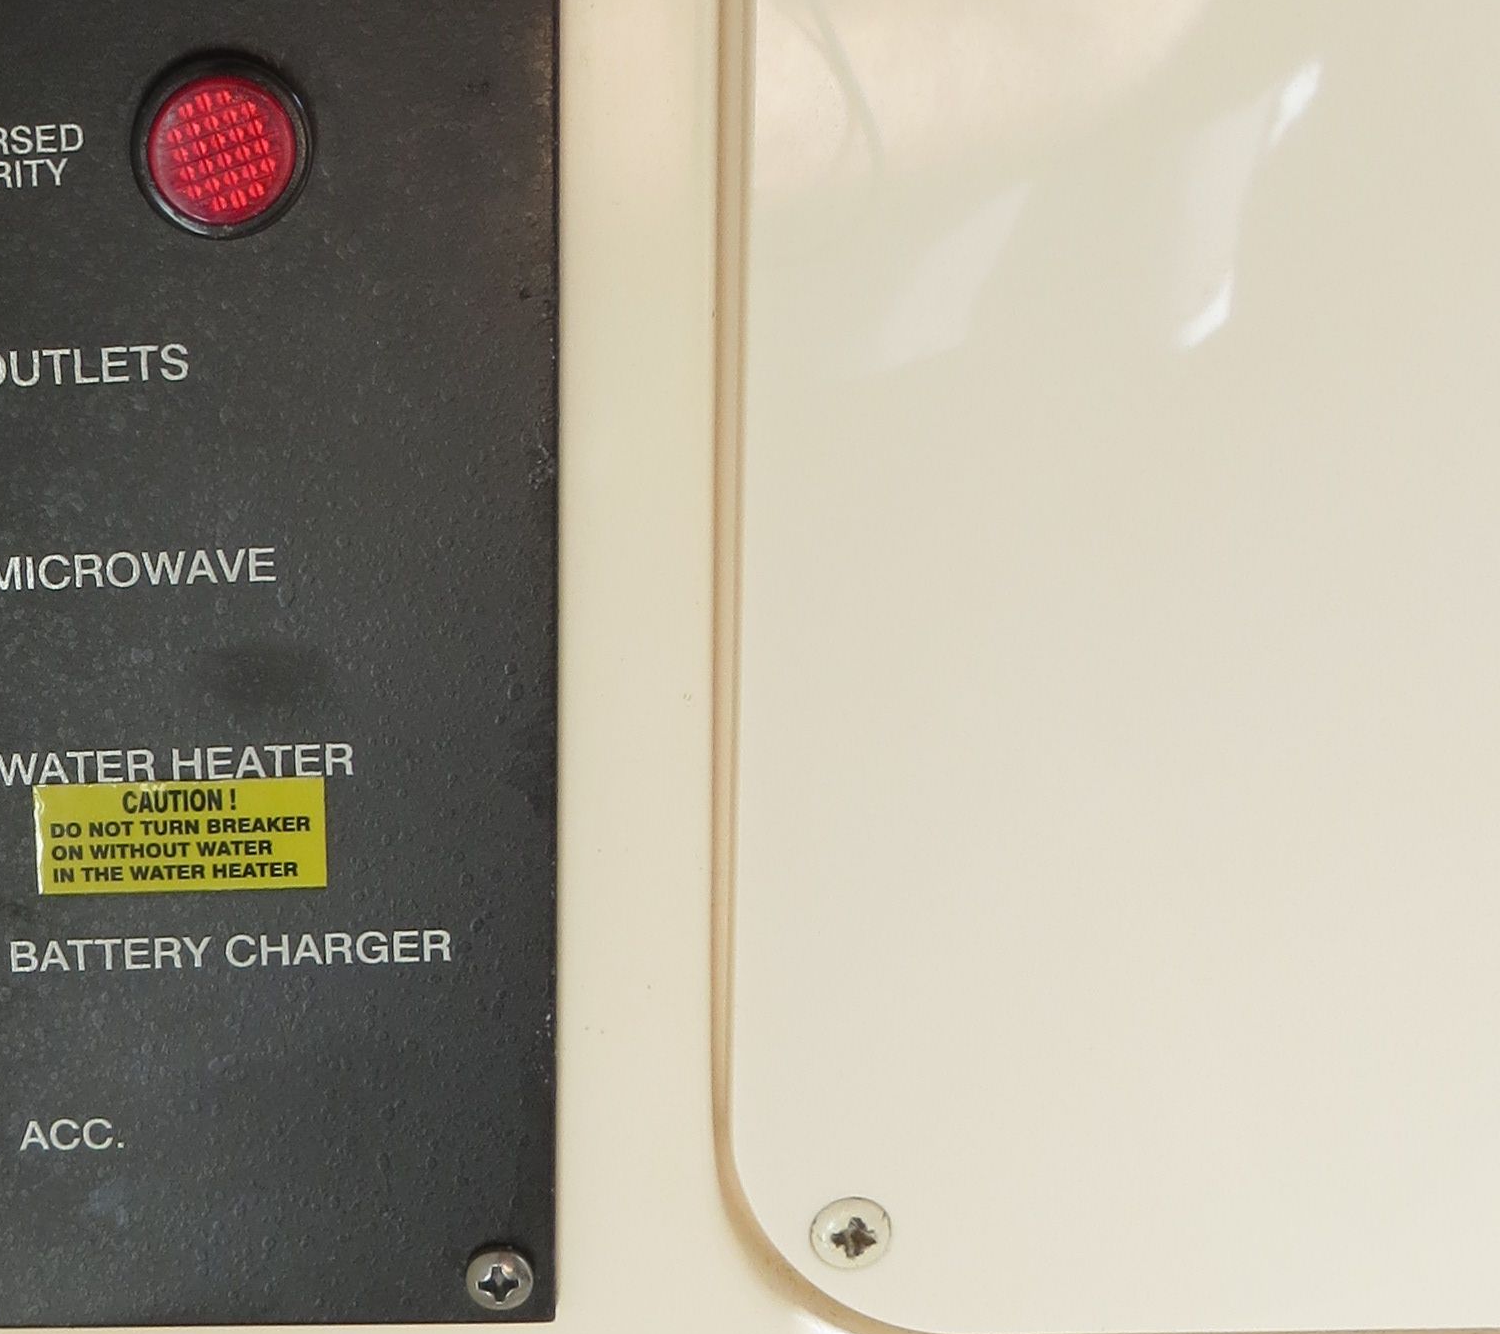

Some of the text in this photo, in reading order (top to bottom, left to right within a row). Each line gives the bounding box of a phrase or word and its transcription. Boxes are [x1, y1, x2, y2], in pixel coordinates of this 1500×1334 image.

[172, 743, 354, 781] HEATER
[122, 788, 223, 814] CAUTION
[50, 816, 310, 839] DO NOT TURN BREAKER
[51, 840, 272, 861] ON WITHOUT WATER
[53, 862, 298, 883] IN THE WATER HEATER
[10, 929, 452, 973] BATTERY CHARGER
[19, 1118, 124, 1151] ACC.
